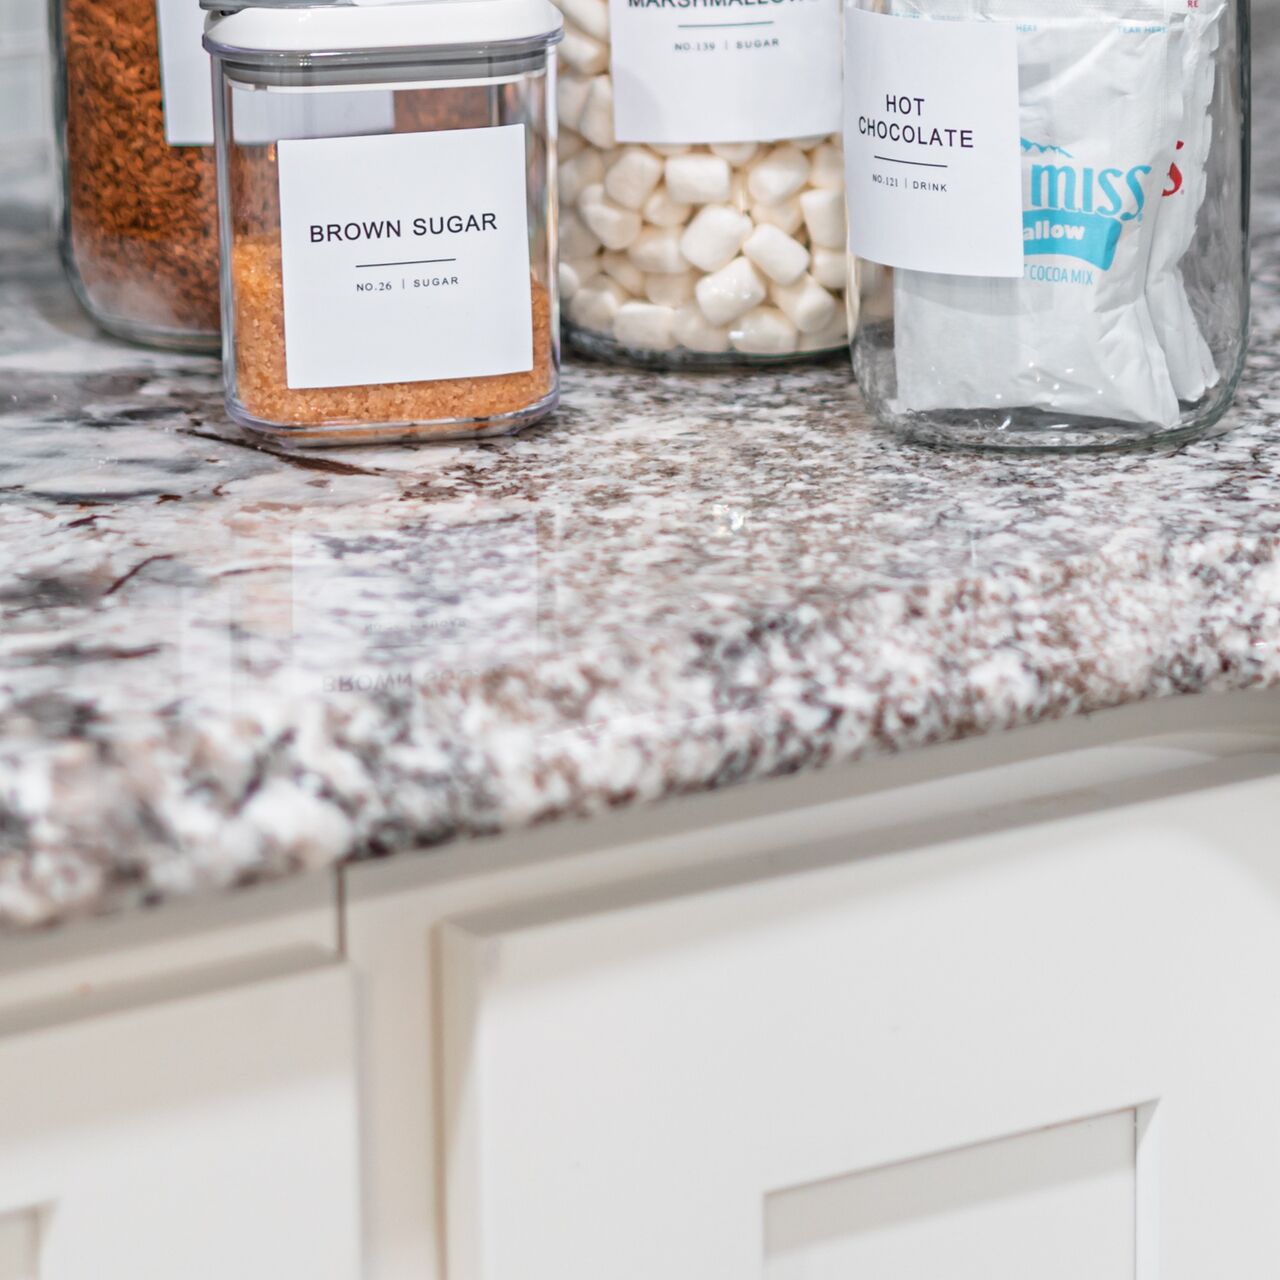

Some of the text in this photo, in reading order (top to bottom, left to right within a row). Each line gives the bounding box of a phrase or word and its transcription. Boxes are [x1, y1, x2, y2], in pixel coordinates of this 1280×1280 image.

[736, 38, 780, 50] SUGAR
[885, 93, 925, 117] HOT
[858, 115, 974, 148] CHOCOLATE
[872, 173, 948, 193] NO.121 DRINK
[309, 212, 498, 243] BROWN SUGAR
[1023, 220, 1086, 242] allow
[356, 276, 459, 293] NO.26 SUGAR
[1029, 263, 1068, 284] COCOA
[1070, 269, 1094, 286] MIX
